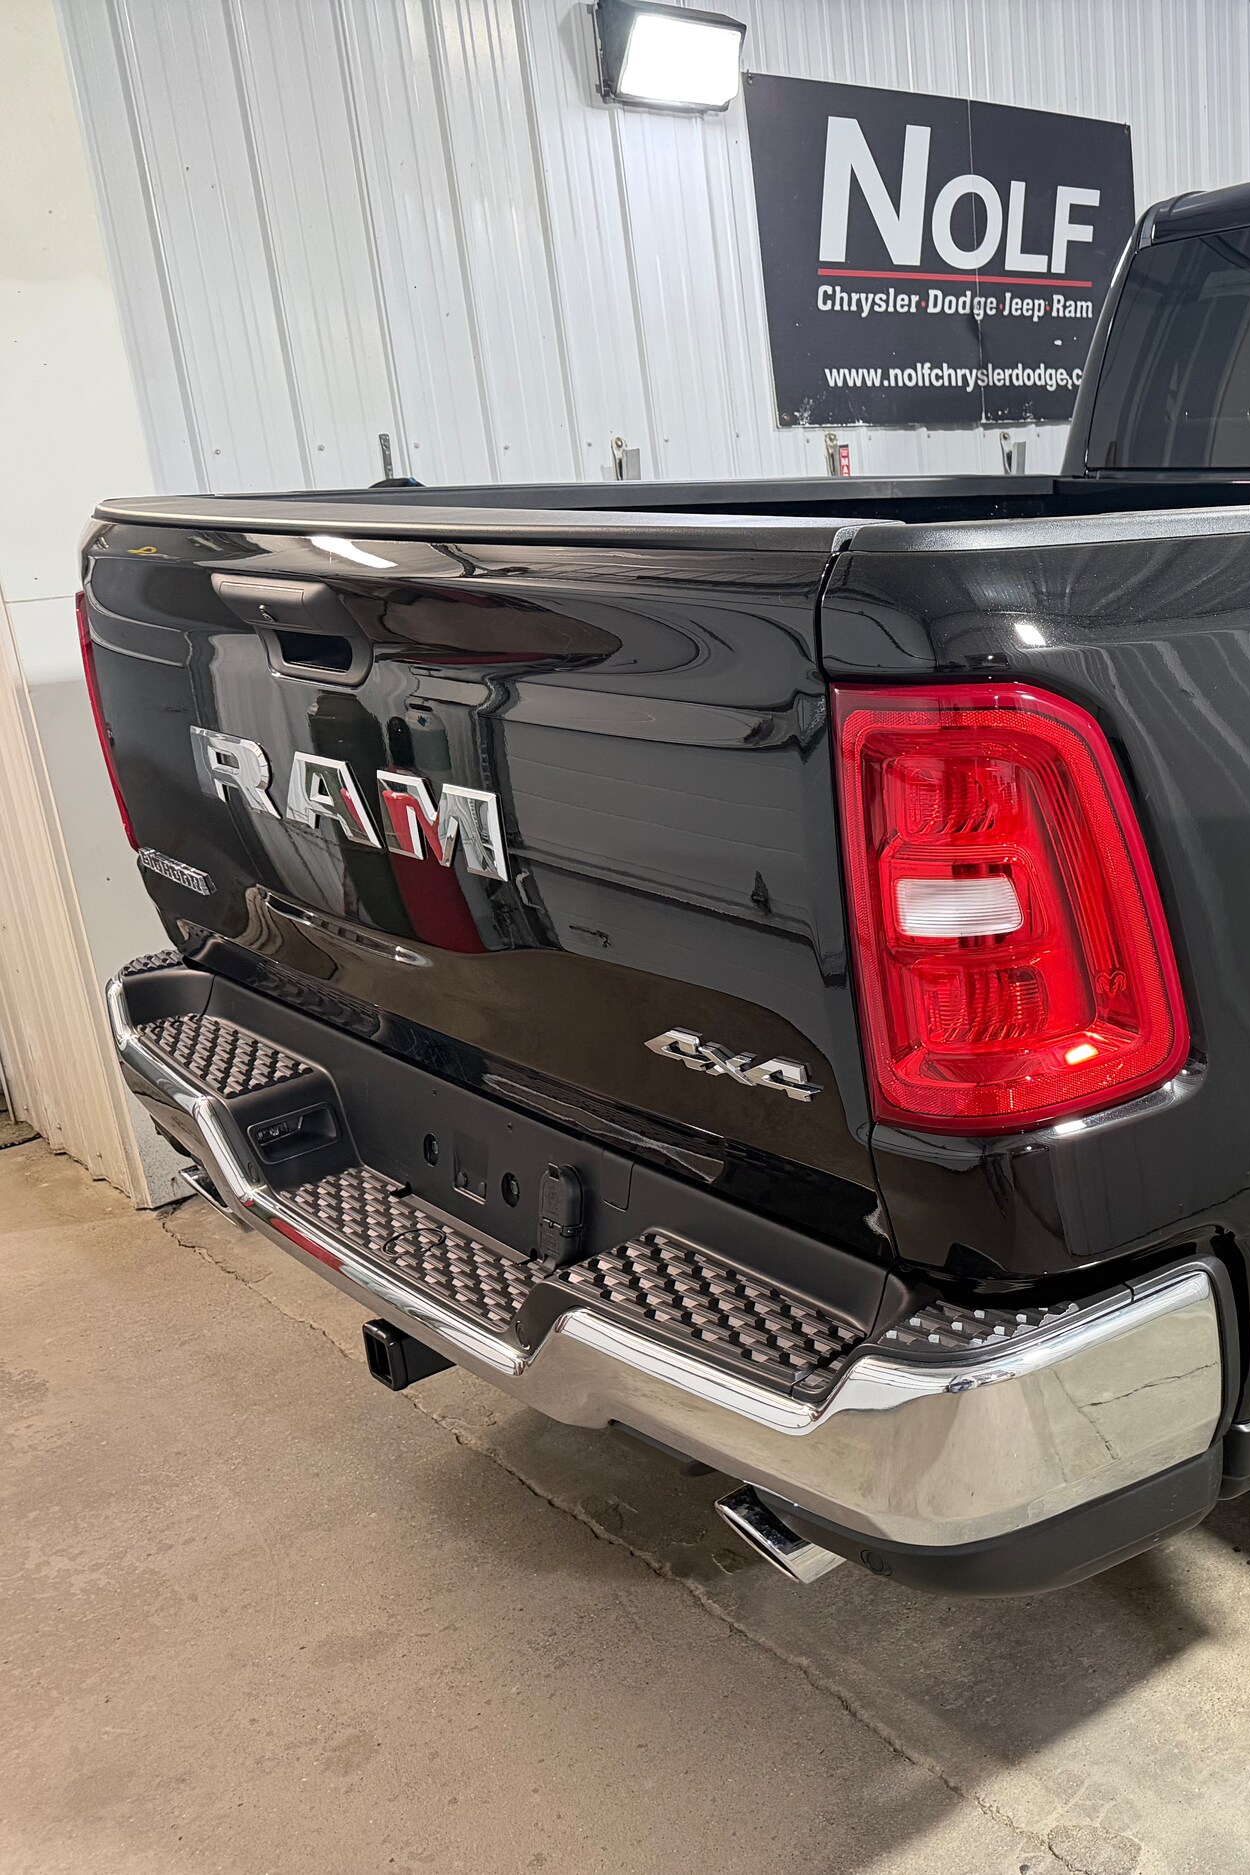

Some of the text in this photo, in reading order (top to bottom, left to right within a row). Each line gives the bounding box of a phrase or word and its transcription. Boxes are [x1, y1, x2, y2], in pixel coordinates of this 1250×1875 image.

[819, 116, 1100, 273] NOLF
[817, 285, 1093, 322] Chrysler Dodge Jeep Ram
[824, 362, 1083, 392] www.nolfchryslerdodge.c
[190, 725, 511, 882] RAM
